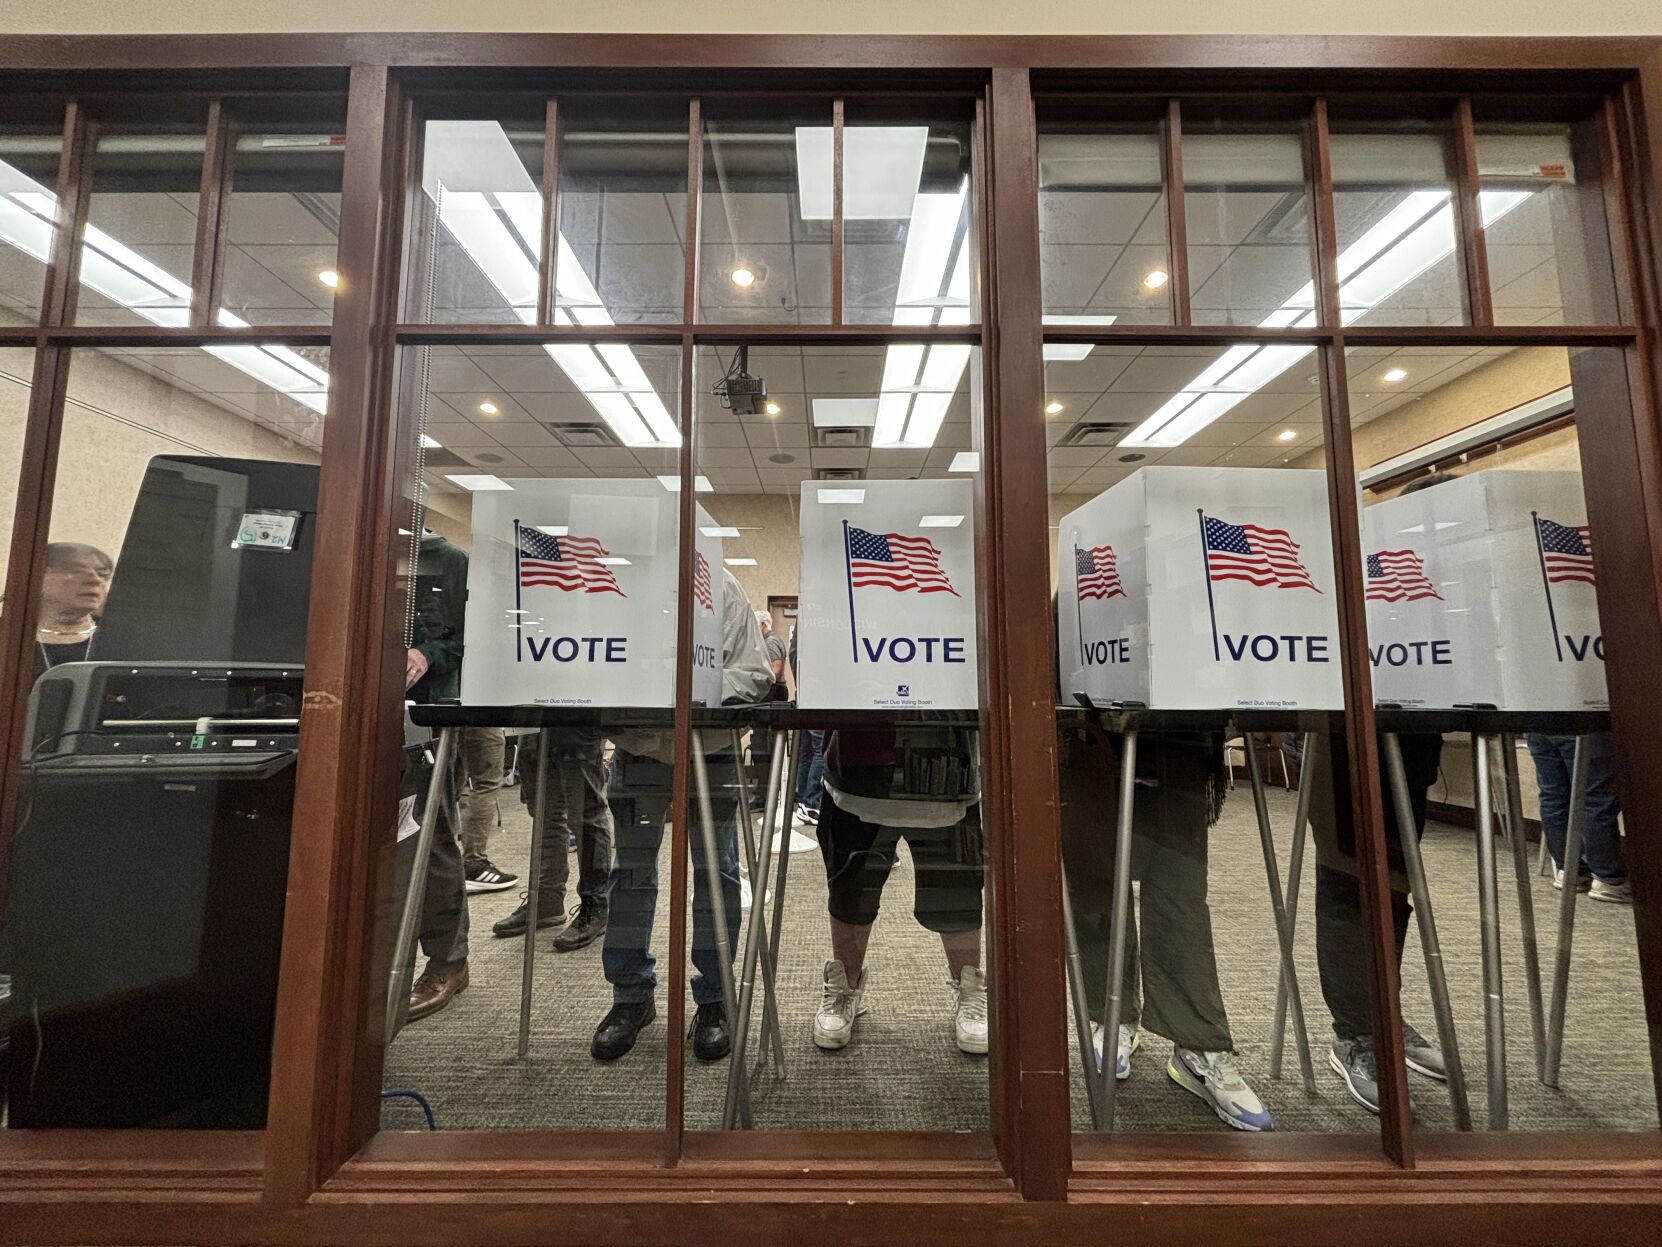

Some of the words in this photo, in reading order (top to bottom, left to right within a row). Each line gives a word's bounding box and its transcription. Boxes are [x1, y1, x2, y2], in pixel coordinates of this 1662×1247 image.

[526, 636, 627, 662] VOTE
[862, 637, 966, 663] VOTE
[1084, 637, 1130, 665] VOTE
[1223, 634, 1329, 662] VOTE
[1369, 640, 1453, 667] VOTE
[1265, 699, 1281, 707] Voting
